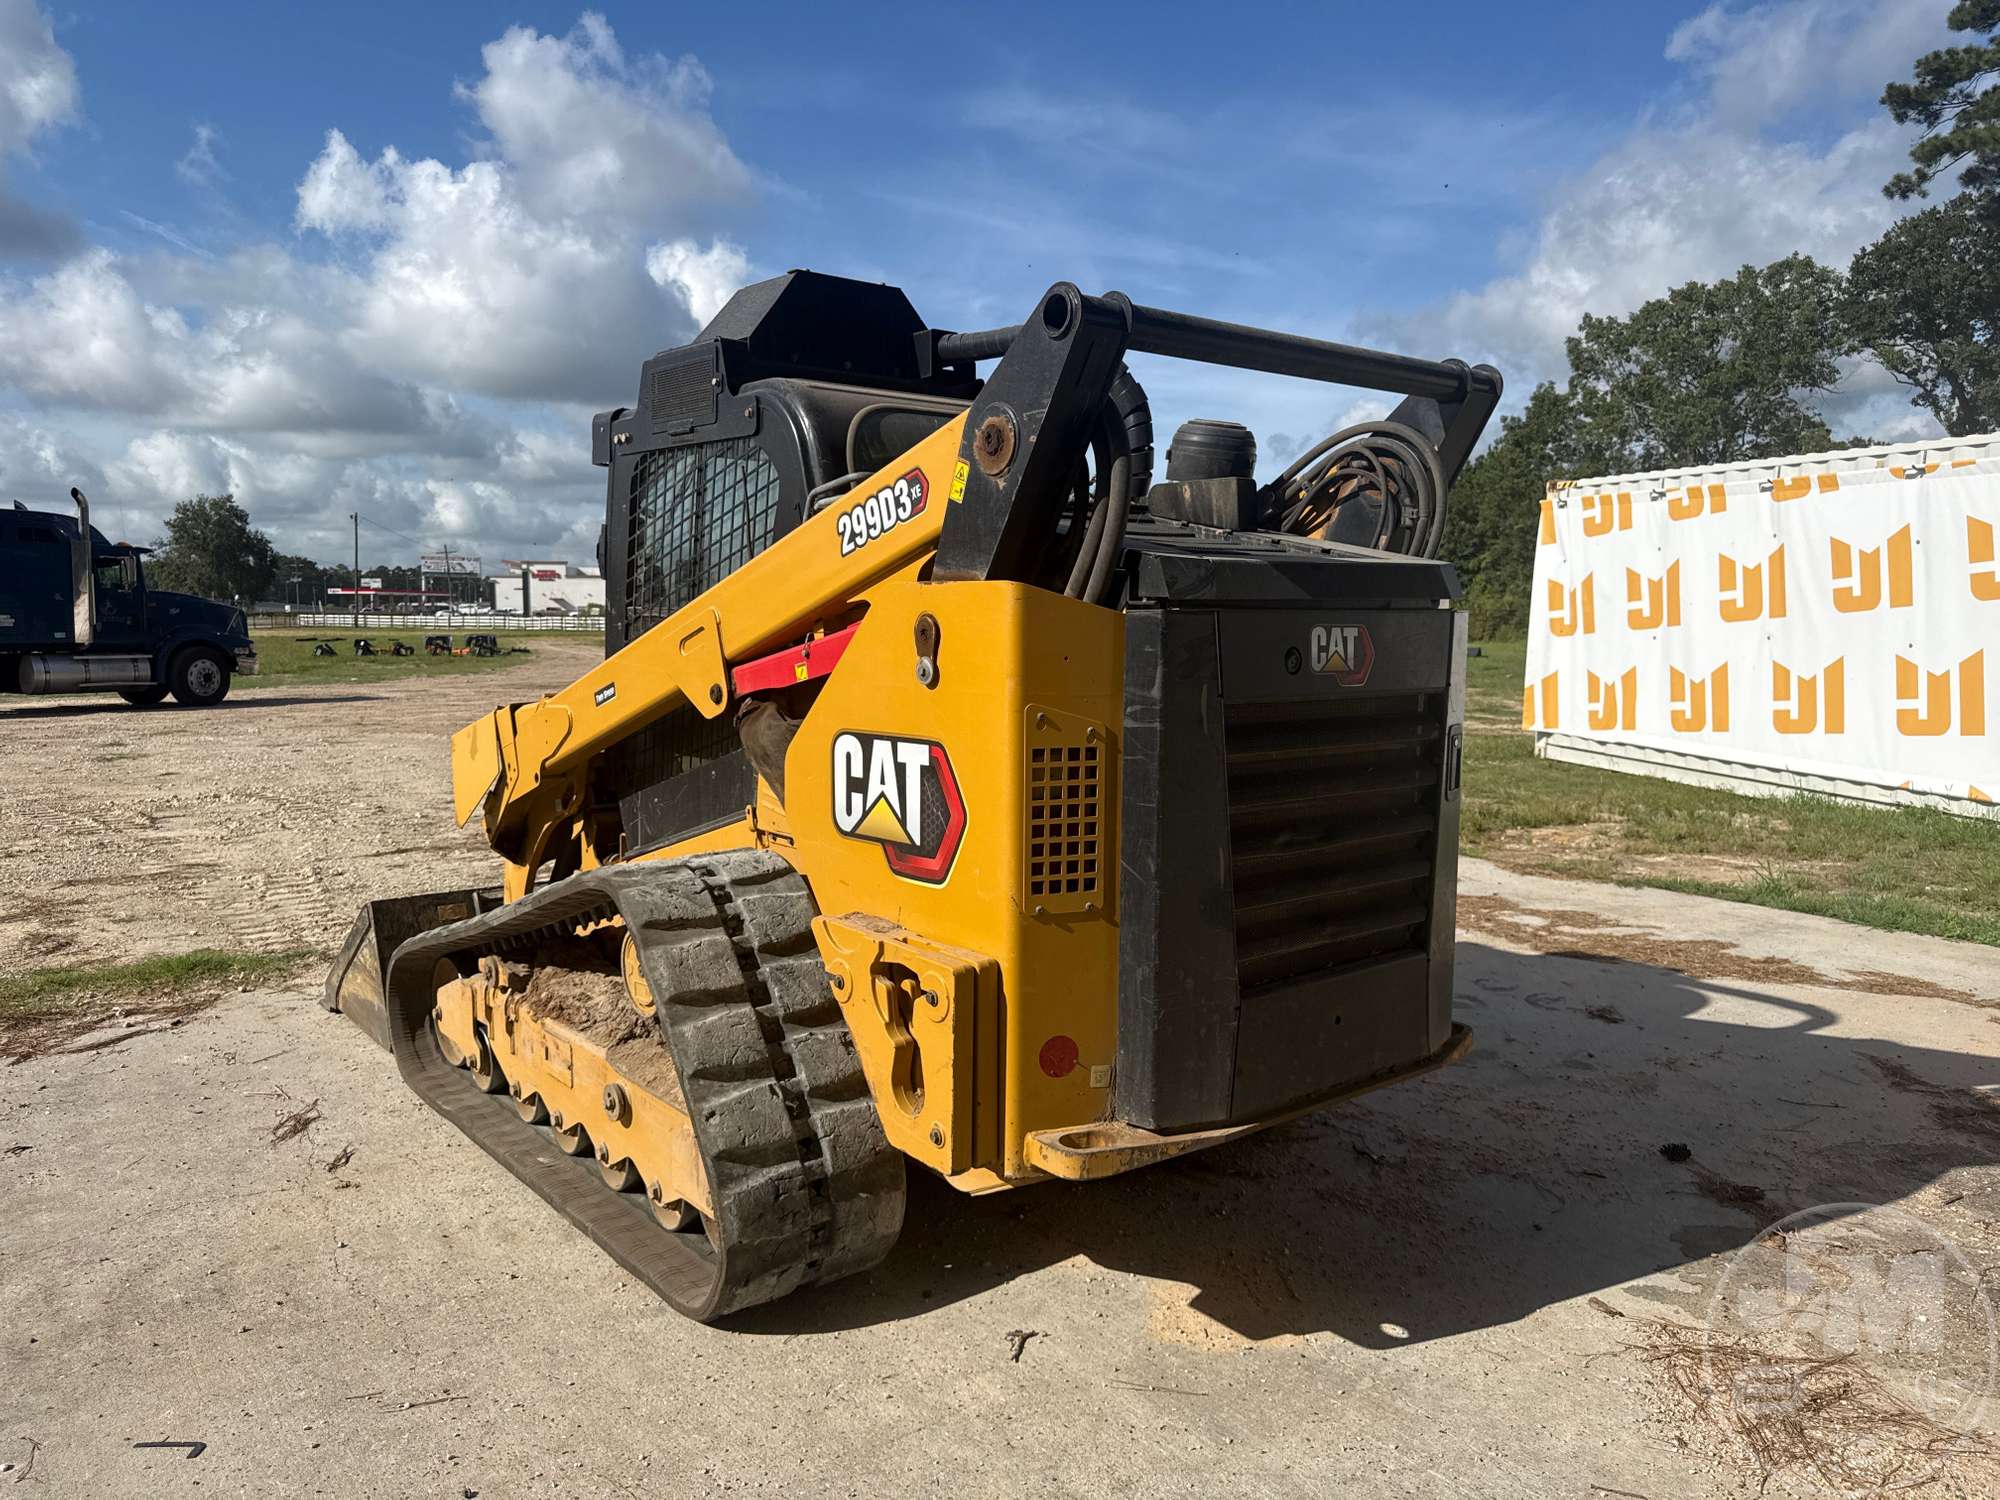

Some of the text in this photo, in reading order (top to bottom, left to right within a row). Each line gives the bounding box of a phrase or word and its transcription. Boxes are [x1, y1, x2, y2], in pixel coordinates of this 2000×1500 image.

[837, 479, 922, 556] 299D3 XE
[1311, 626, 1359, 671] CAT
[834, 734, 930, 847] CAT
